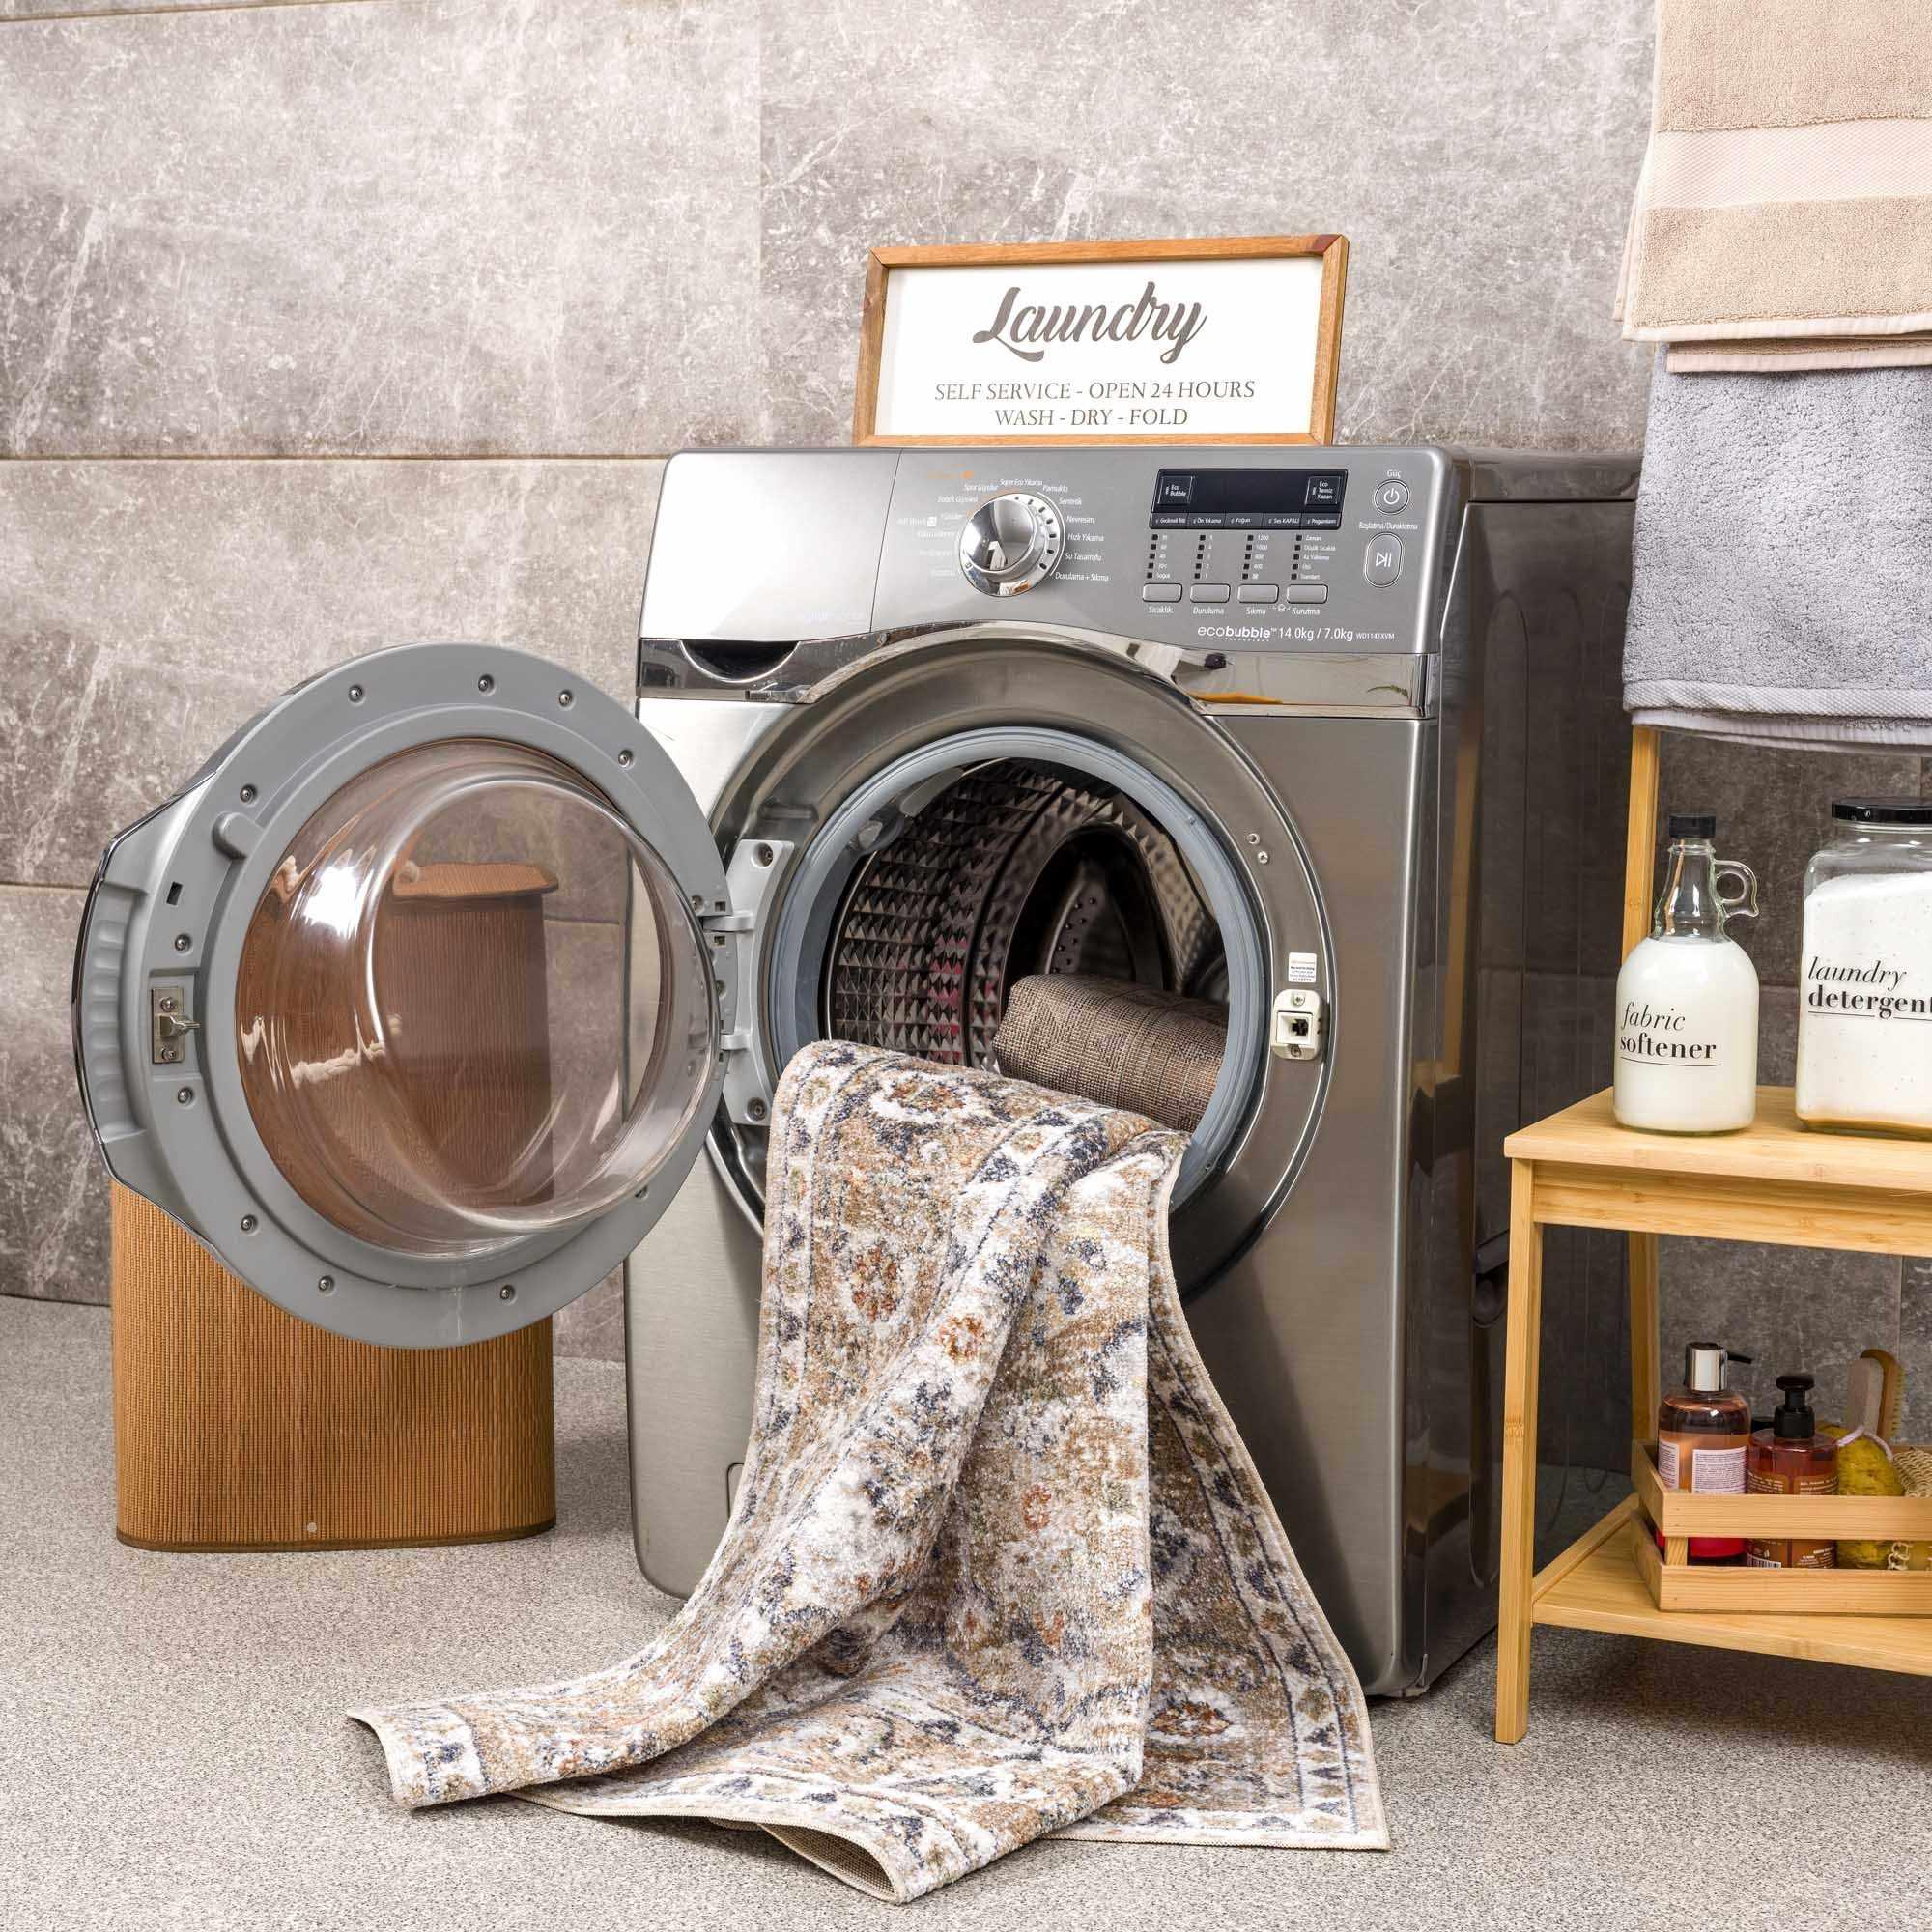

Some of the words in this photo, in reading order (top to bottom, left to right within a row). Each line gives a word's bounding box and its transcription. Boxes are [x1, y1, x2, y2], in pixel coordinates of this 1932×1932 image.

[972, 281, 1208, 364] Laundry
[934, 383, 982, 401] SELF
[985, 382, 1071, 400] SERVICE
[1089, 382, 1146, 399] OPEN
[1151, 382, 1174, 399] 24
[1179, 380, 1255, 399] HOURS
[994, 410, 1053, 426] WASH
[1070, 409, 1112, 426] DRY
[1129, 408, 1188, 425] FOLD
[1278, 627, 1314, 641] 14.0kg
[1325, 628, 1353, 642] 7.0kg
[1807, 956, 1907, 992] laundry
[1620, 1001, 1686, 1031] fabric
[1619, 1033, 1717, 1060] softener
